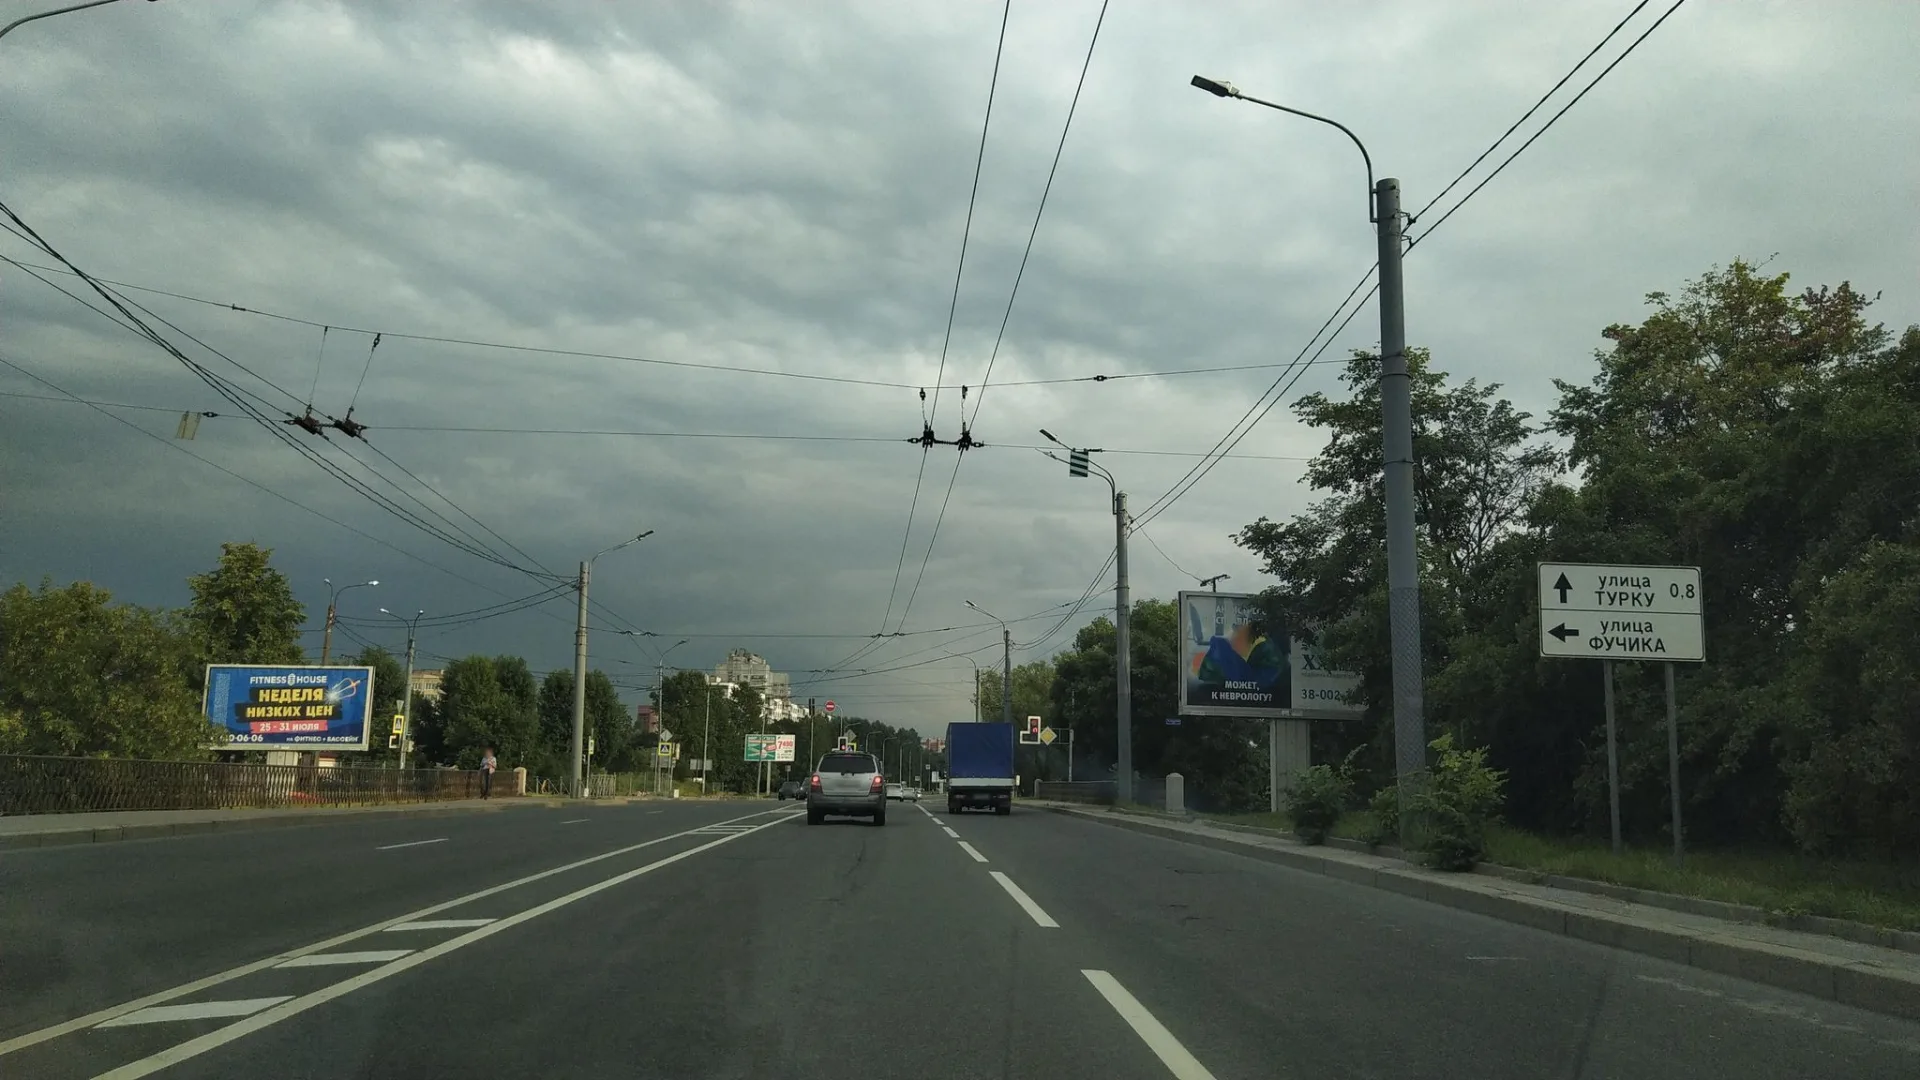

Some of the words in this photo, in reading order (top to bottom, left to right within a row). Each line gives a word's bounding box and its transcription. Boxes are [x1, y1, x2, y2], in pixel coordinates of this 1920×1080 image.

[1598, 575, 1651, 589] улица
[1669, 583, 1695, 600] 0,8
[1594, 591, 1655, 607] ТУРКУ
[1600, 620, 1653, 634] улица
[1588, 636, 1666, 653] ФУЧИКА
[250, 676, 286, 684] FITNESS
[296, 675, 328, 684] HOUSE
[1225, 680, 1260, 691] МОЖЕТ,
[259, 688, 323, 703] НЕДЕЛЯ
[1211, 691, 1219, 700] К
[1219, 691, 1273, 702] НЕВРОЛОГУ?
[246, 706, 301, 718] НИЗКИХ
[305, 705, 333, 718] ЦЕН
[259, 723, 271, 732] 25
[279, 723, 290, 731] 31
[292, 723, 320, 731] ИЮЛЯ
